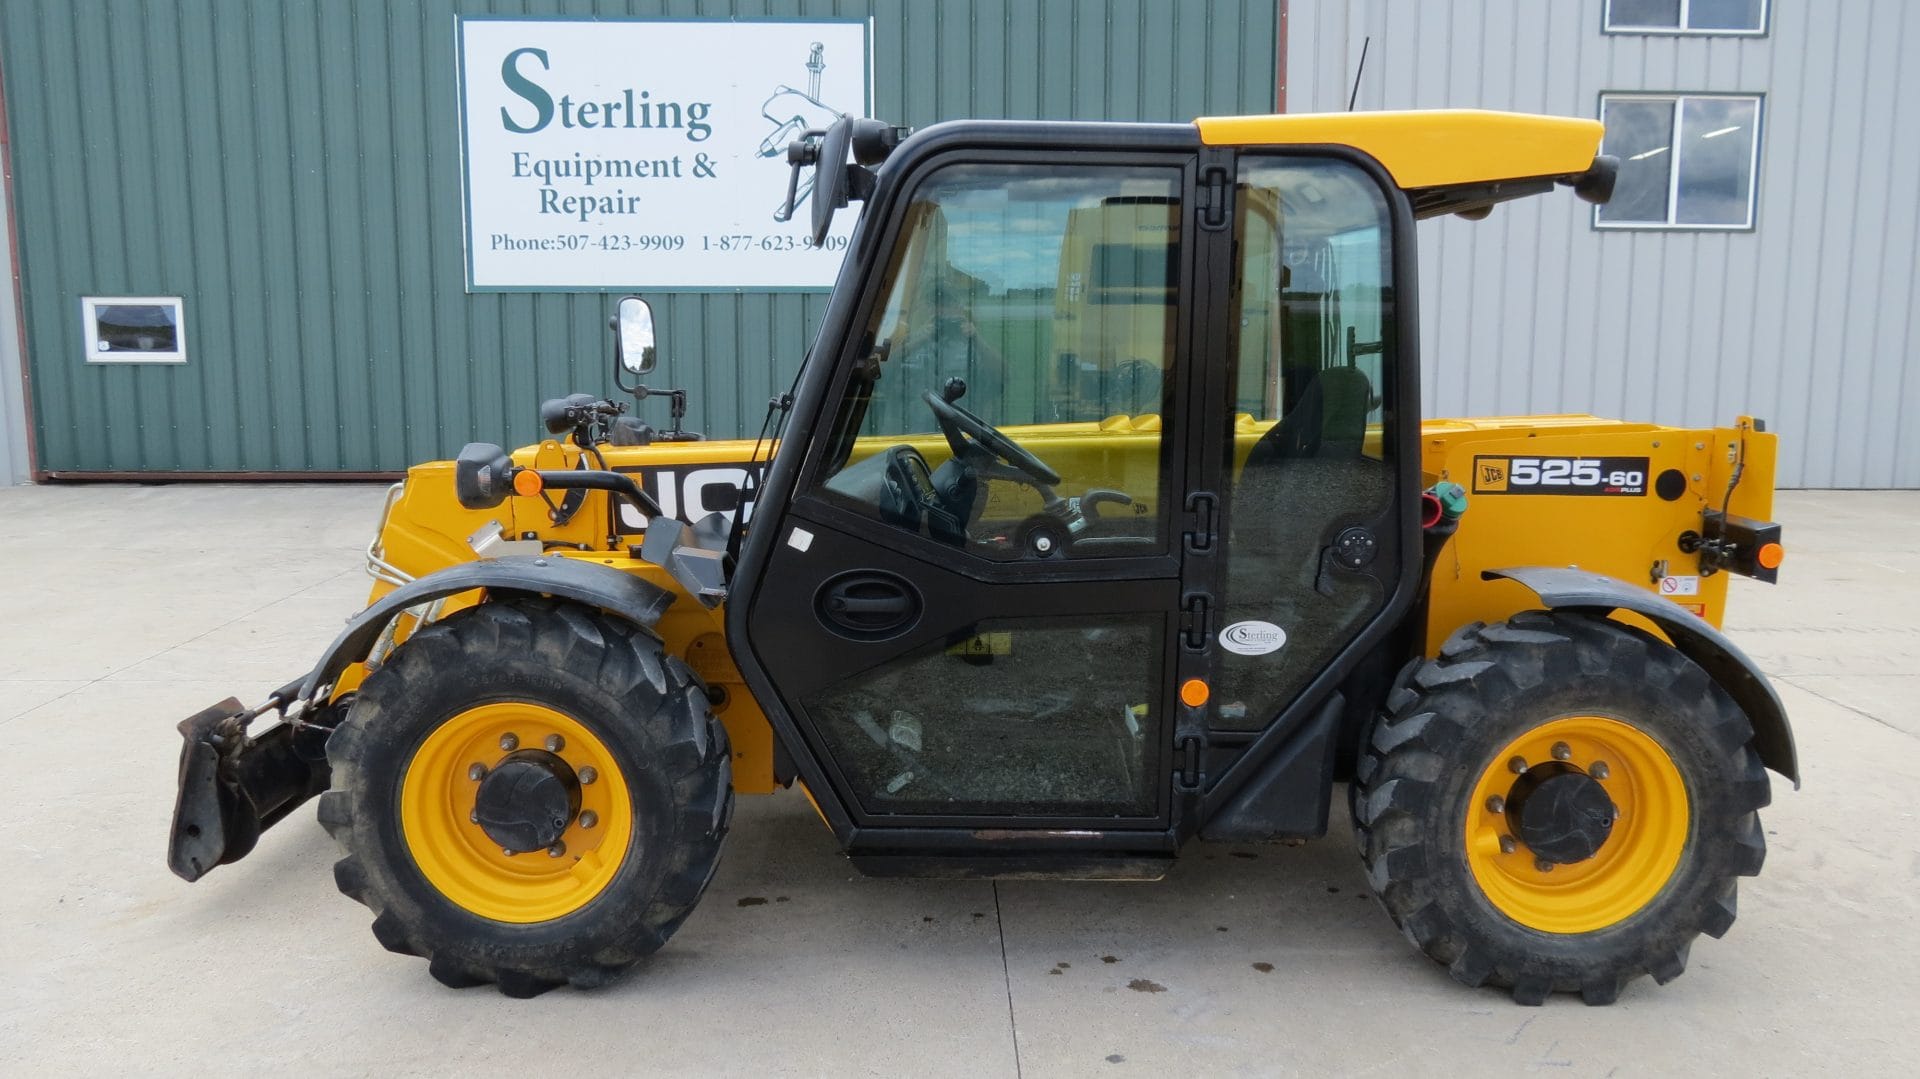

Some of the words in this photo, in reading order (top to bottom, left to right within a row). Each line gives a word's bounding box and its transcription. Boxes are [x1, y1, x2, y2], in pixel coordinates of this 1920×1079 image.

[501, 47, 711, 142] Sterling
[511, 152, 682, 186] Equipment
[692, 152, 718, 179] &
[538, 189, 640, 222] Repair
[491, 234, 685, 251] Phone:507-423-9909
[702, 235, 848, 251] 1-877-623-909
[1483, 466, 1504, 484] JCB
[1510, 458, 1643, 486] 525-60
[1239, 628, 1278, 641] Sterling
